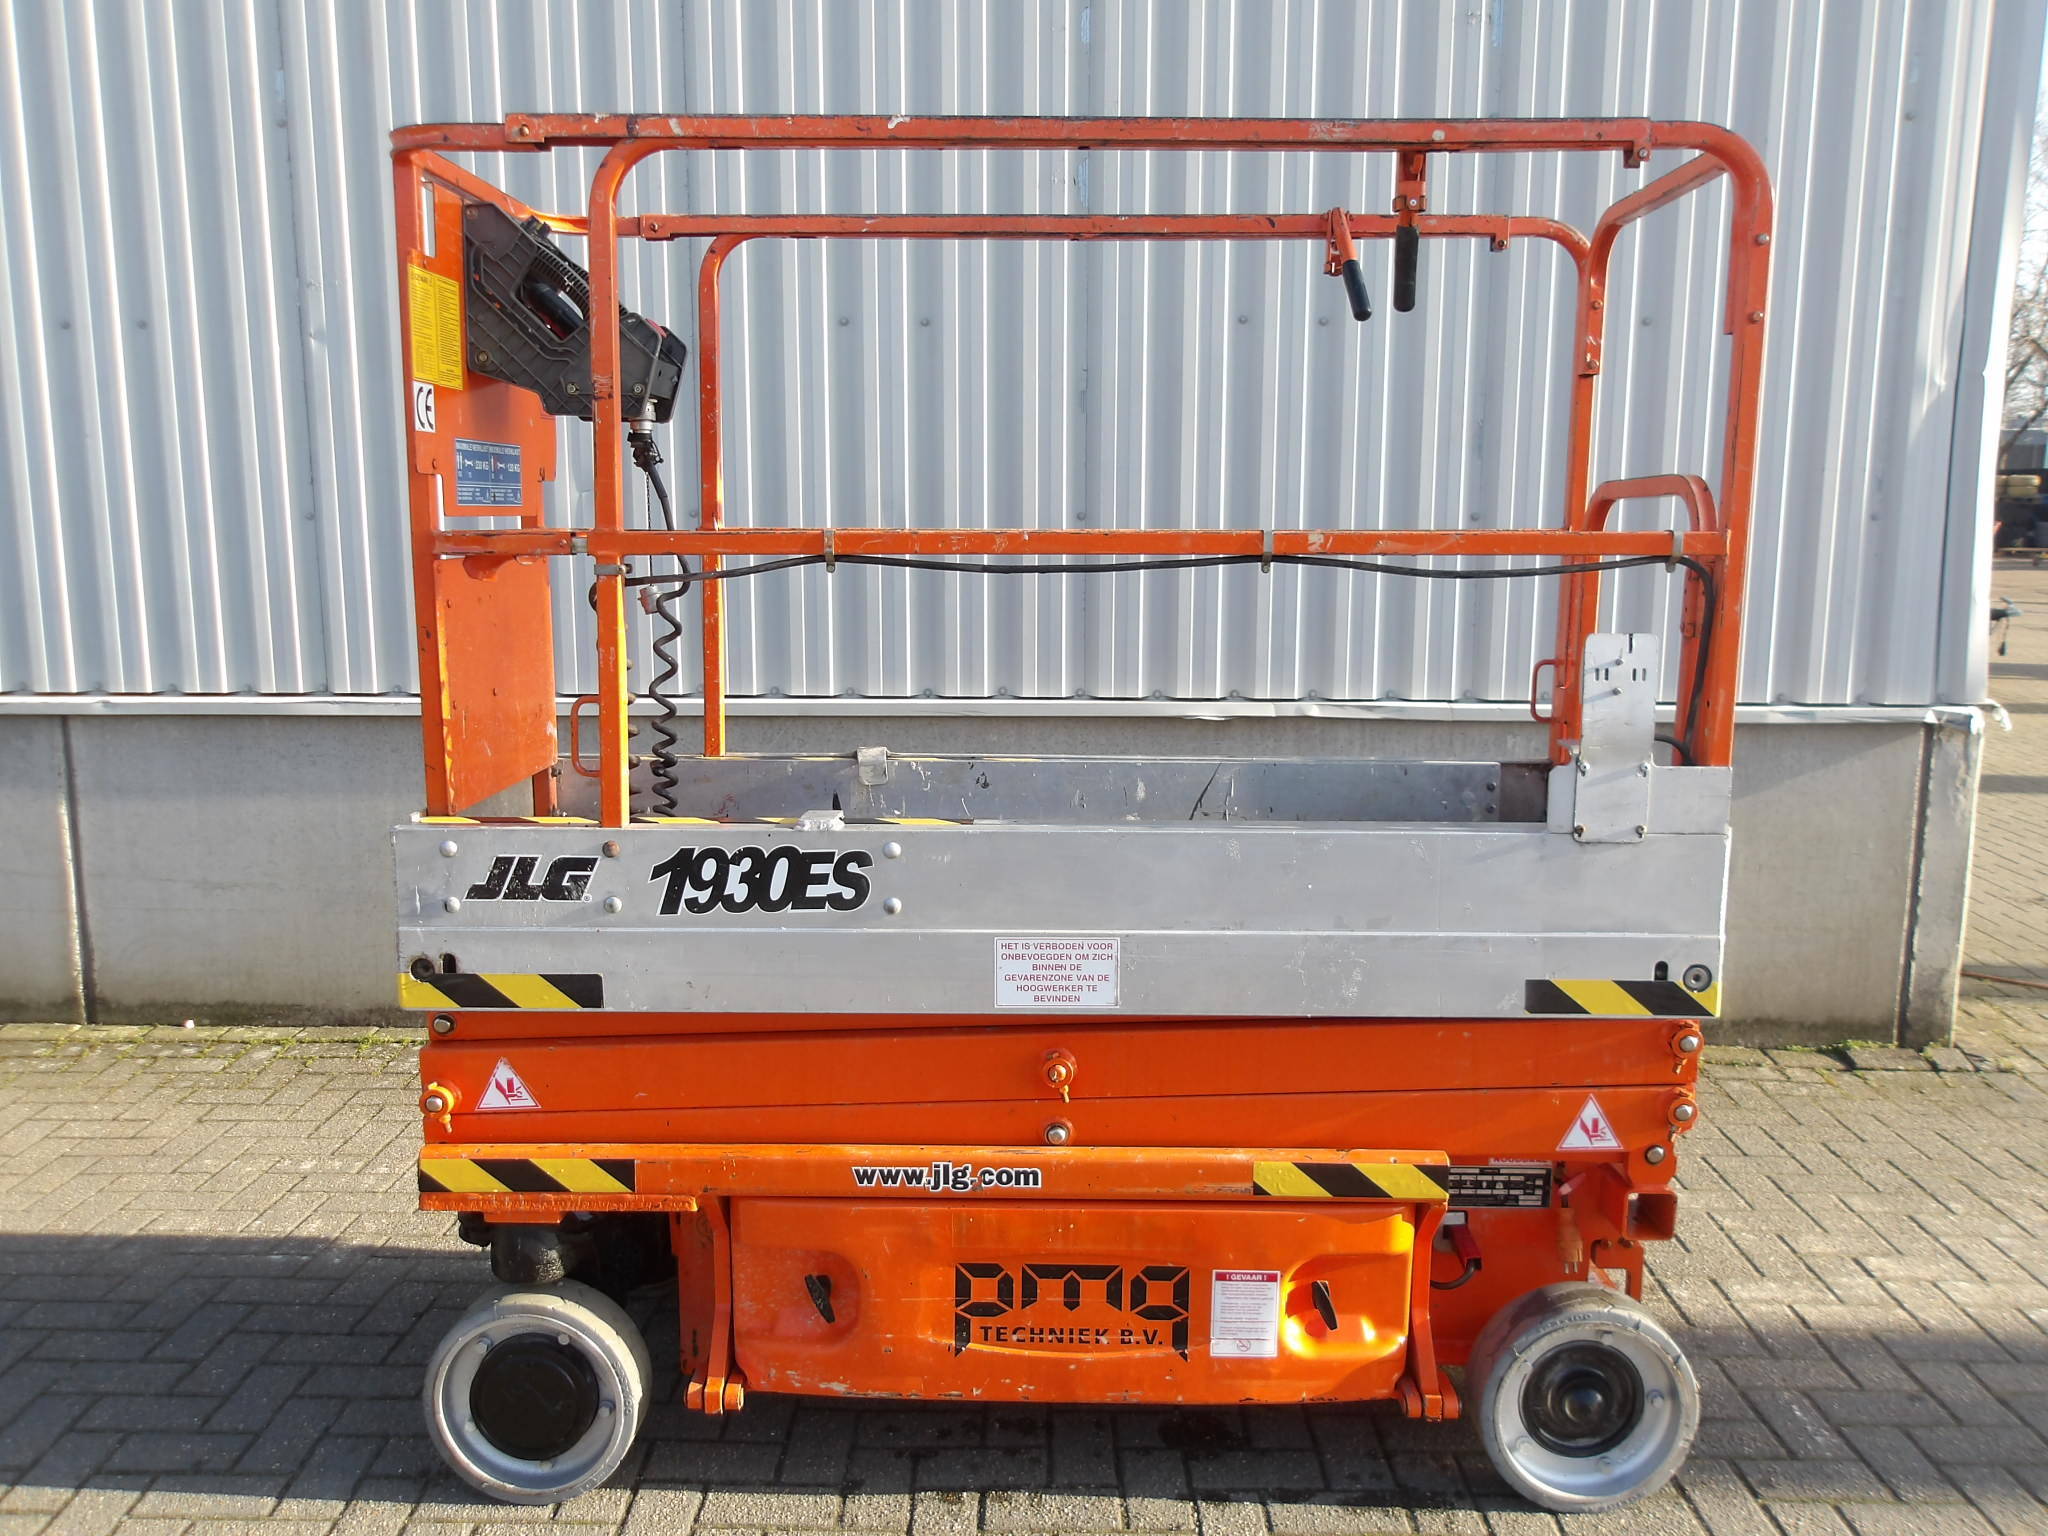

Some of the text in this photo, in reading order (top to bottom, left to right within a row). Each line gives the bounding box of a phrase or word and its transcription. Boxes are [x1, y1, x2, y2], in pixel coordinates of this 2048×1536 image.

[648, 844, 875, 916] 1930ES
[1001, 953, 1072, 961] ONBEVOEGDEN
[1016, 984, 1084, 992] HOOGWERKER
[852, 1163, 1042, 1192] www.jlg.com
[979, 1326, 1164, 1345] TECHNIEK B.V.
